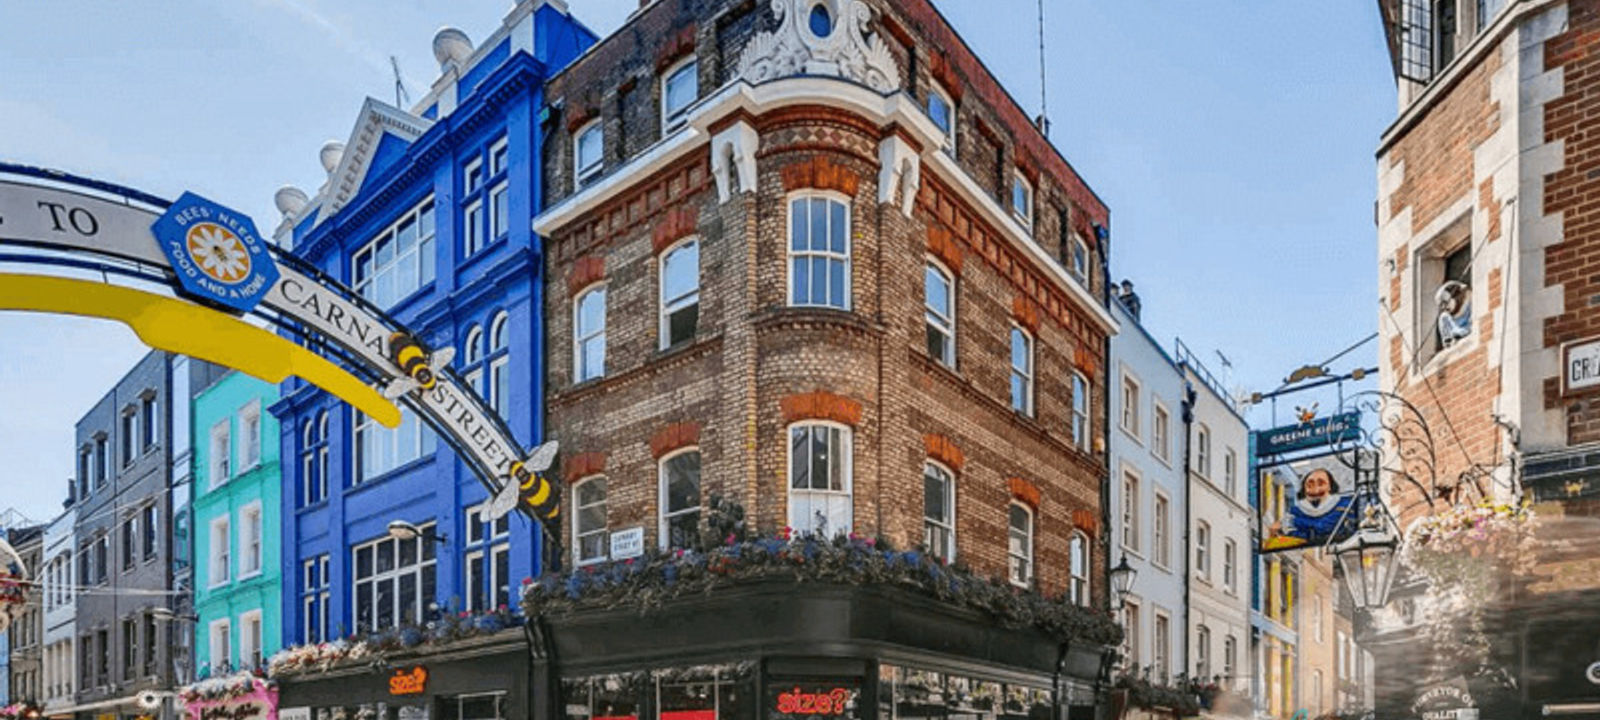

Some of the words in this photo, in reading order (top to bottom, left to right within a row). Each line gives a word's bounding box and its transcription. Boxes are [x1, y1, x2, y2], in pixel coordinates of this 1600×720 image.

[37, 201, 99, 236] TO
[219, 213, 260, 254] NEEDS
[170, 241, 197, 277] FOOD
[197, 278, 226, 297] AND
[229, 289, 240, 299] A
[239, 273, 266, 298] HOME
[431, 383, 510, 470] STREET
[1270, 428, 1312, 445] GREENE
[777, 685, 848, 715] size?
[1422, 710, 1459, 720] QUALIT
